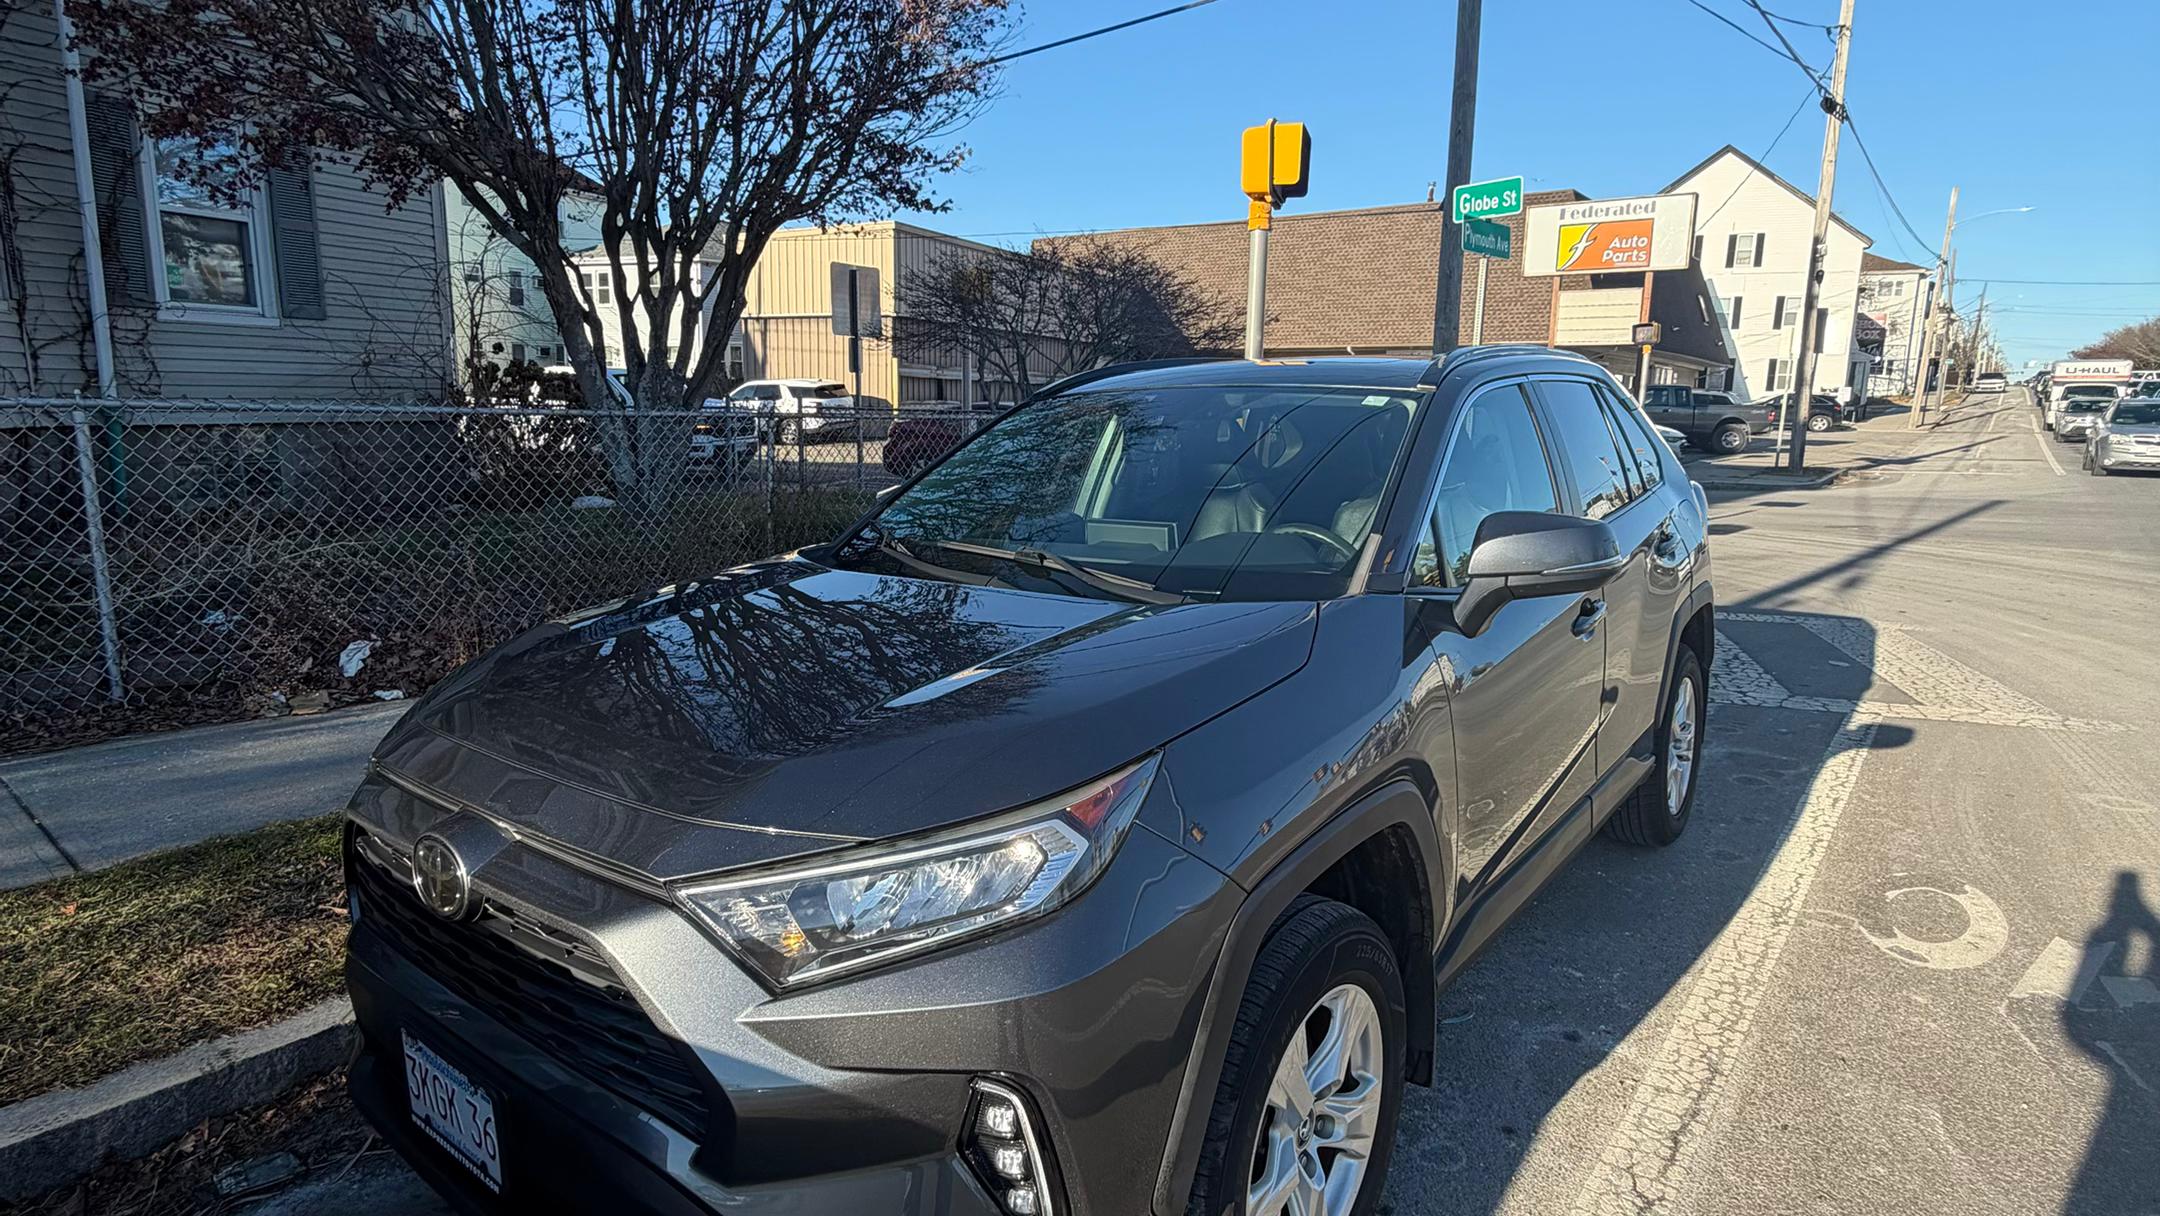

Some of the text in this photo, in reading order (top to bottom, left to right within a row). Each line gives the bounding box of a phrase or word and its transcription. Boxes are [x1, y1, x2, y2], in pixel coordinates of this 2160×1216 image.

[1460, 189, 1517, 214] Globe St
[1559, 200, 1657, 220] Federated
[1465, 222, 1509, 253] Plymouth Ave
[1608, 234, 1649, 249] Auto
[1601, 248, 1648, 263] Parts
[2065, 366, 2120, 374] U-HAUL
[404, 1052, 497, 1161] 3KGK 36
